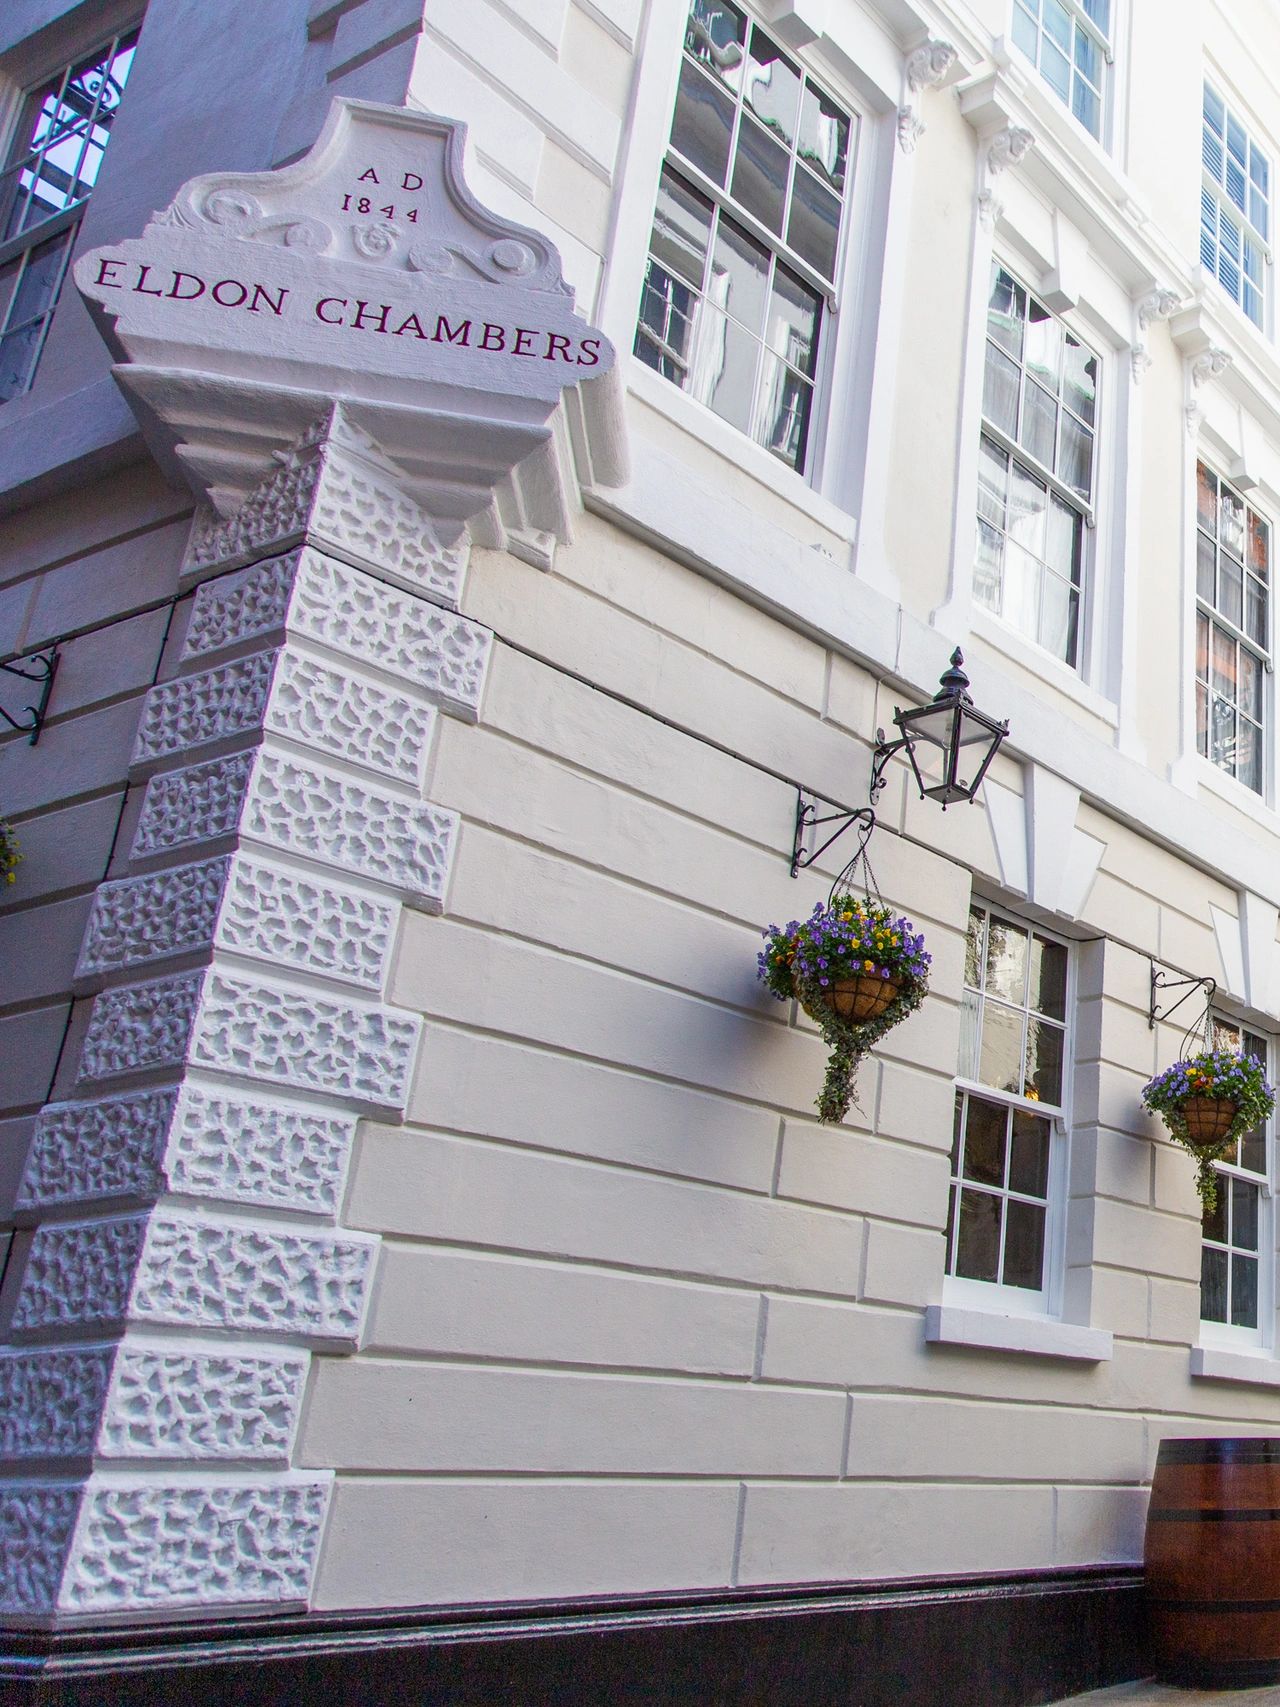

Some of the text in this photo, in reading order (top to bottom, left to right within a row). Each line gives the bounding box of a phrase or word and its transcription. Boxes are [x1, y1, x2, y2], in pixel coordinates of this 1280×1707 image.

[357, 167, 424, 191] A D
[341, 194, 418, 223] 1844
[94, 258, 601, 366] ELDON CHAMBERS
